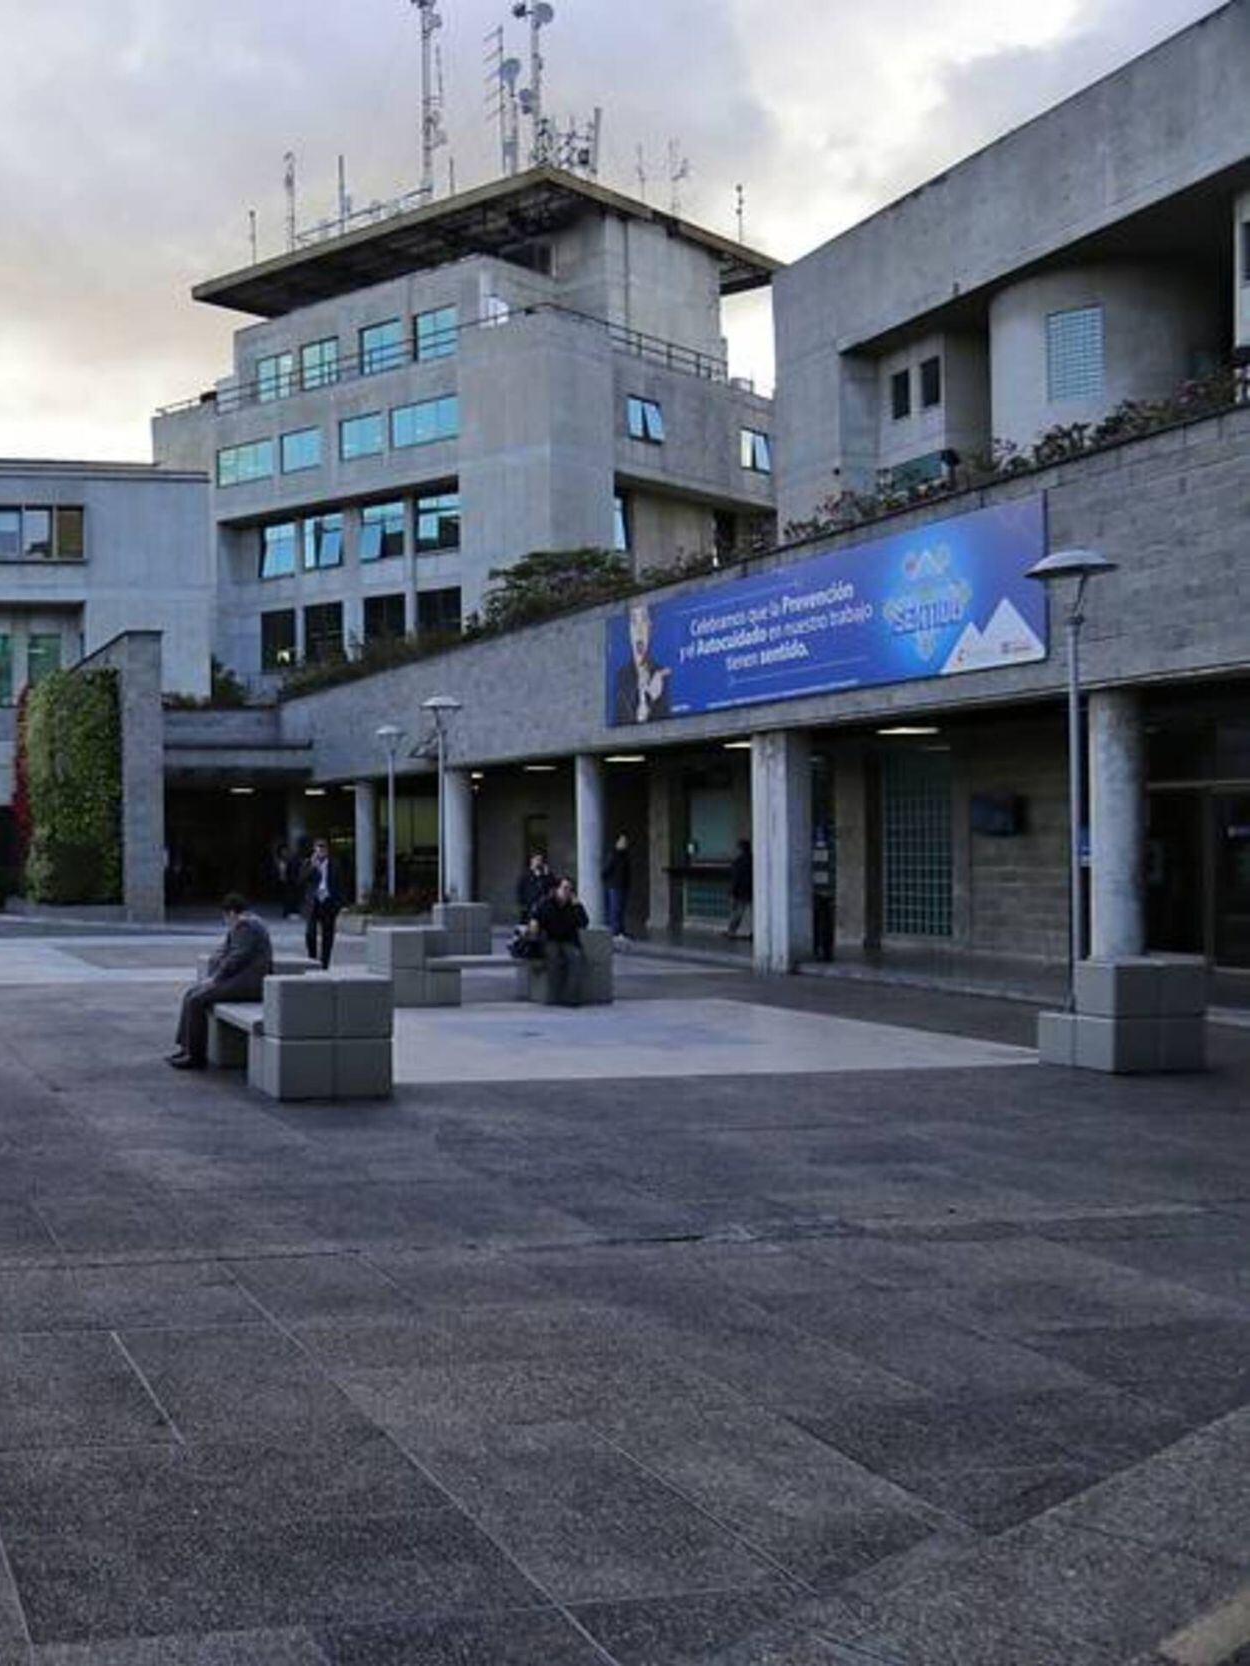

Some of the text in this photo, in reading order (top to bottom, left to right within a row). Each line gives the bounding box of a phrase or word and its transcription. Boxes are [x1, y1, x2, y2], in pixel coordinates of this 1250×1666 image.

[690, 612, 746, 637] Celebramos
[748, 608, 768, 625] que
[782, 581, 854, 614] Prevención
[697, 626, 768, 656] Autocuidado
[782, 615, 828, 637] nuestro
[829, 602, 873, 627] trabajo
